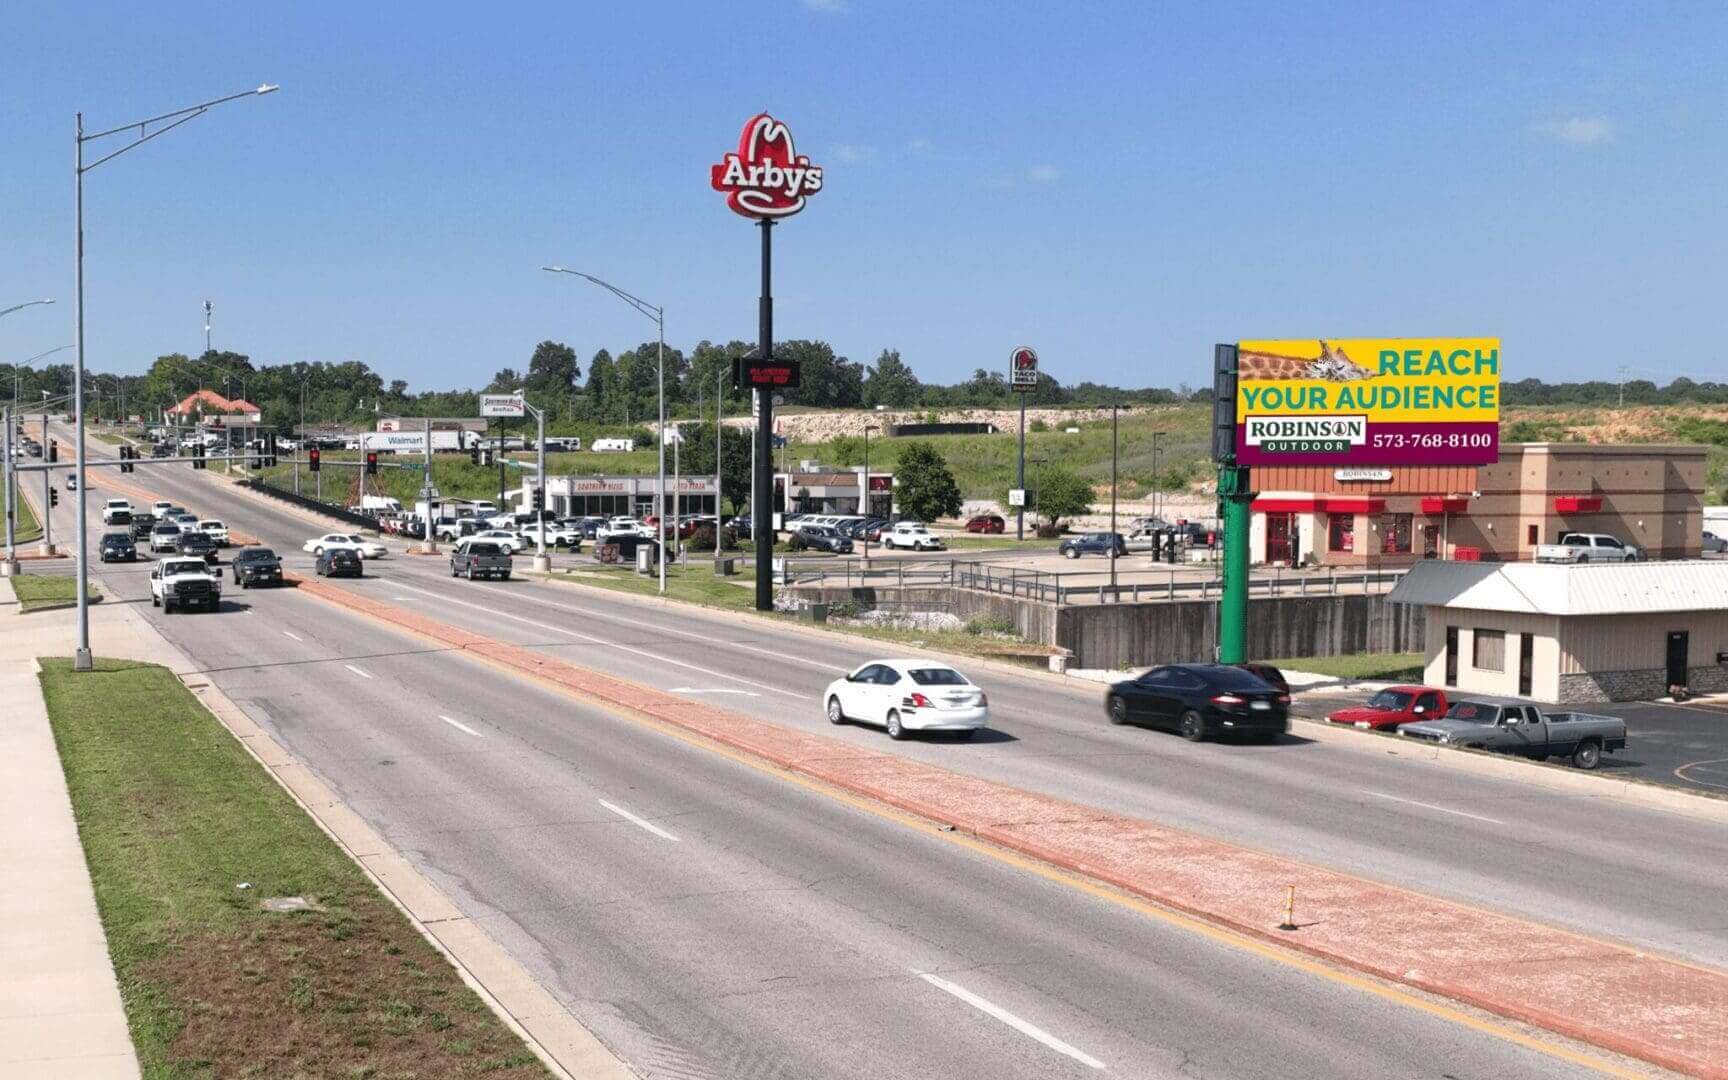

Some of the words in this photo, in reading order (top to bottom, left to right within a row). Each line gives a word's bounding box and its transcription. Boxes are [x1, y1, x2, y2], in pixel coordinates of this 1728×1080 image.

[722, 156, 822, 197] Arby's
[1378, 349, 1498, 376] REACH
[1241, 386, 1328, 410] YOUR
[1335, 385, 1496, 409] AUDIENCE
[1251, 421, 1361, 437] ROBINSON
[388, 436, 423, 444] Walmart
[1268, 442, 1344, 451] OUTDOOR
[1373, 433, 1492, 448] 573-768-8100
